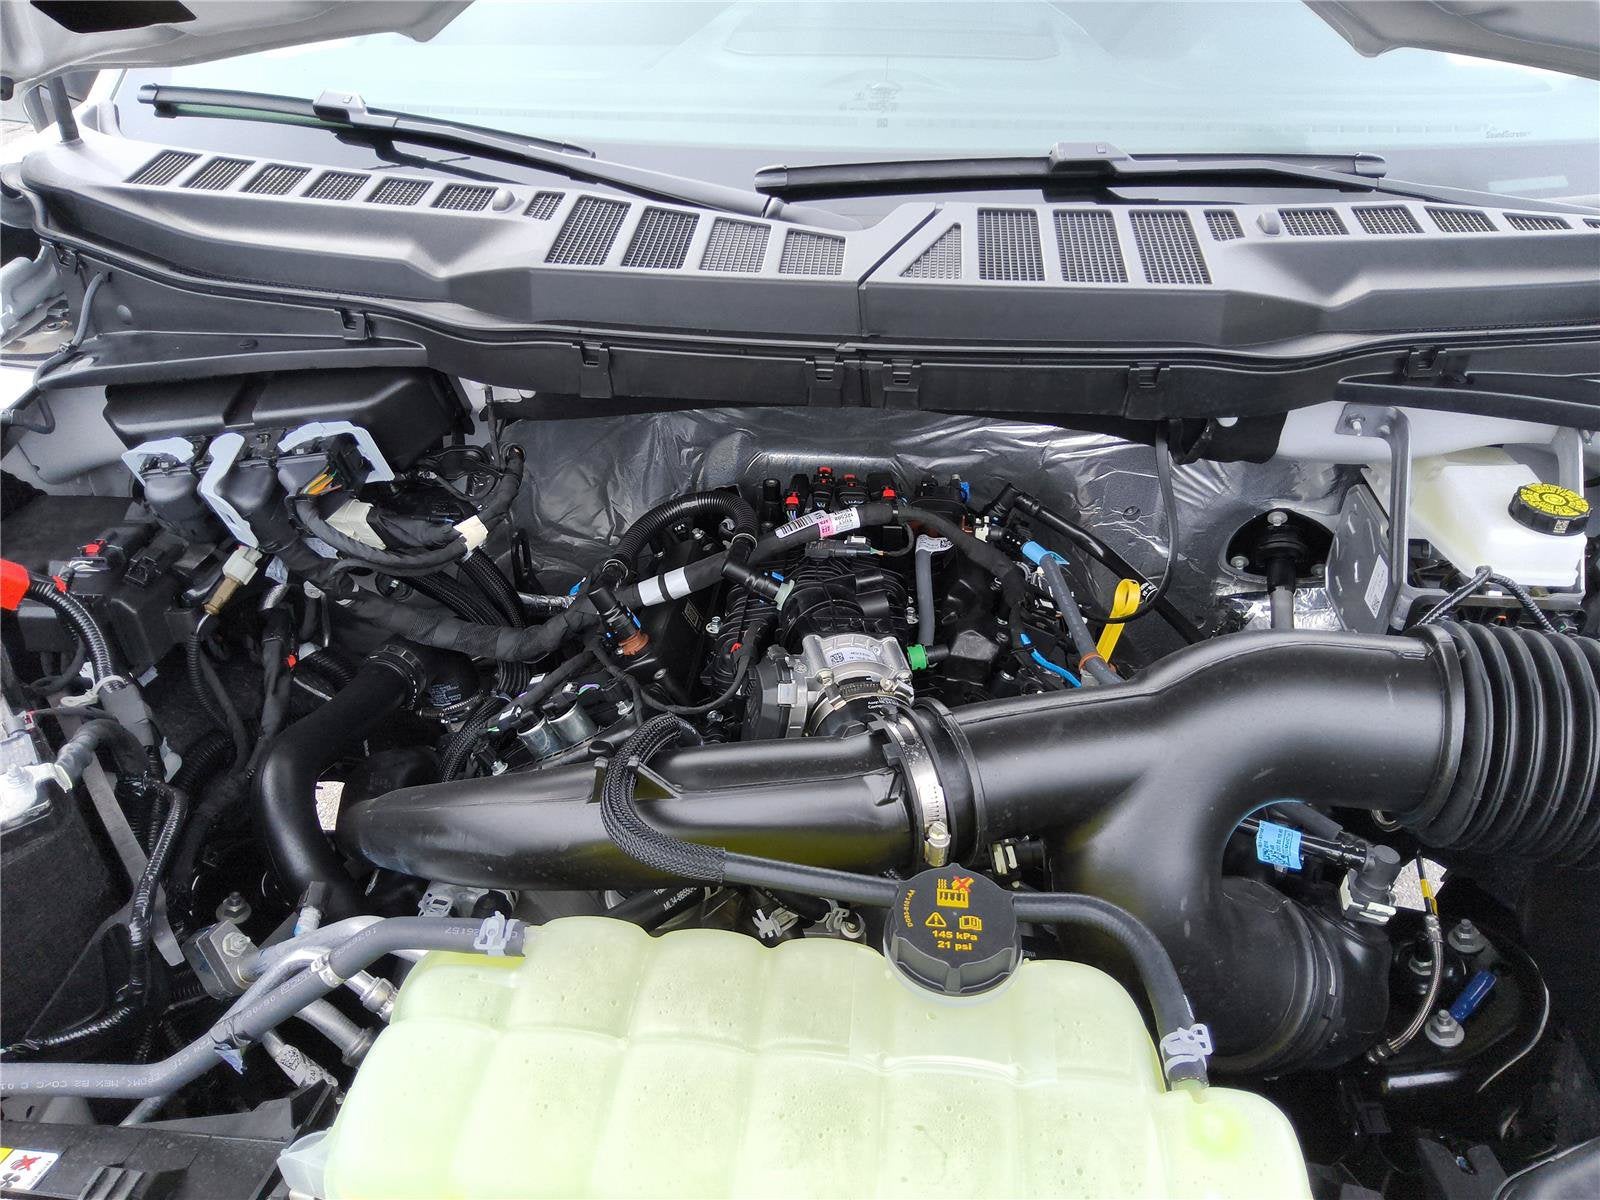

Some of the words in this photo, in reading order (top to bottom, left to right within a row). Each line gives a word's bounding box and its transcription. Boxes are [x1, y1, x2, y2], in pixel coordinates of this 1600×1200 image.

[932, 929, 953, 939] 145
[955, 931, 978, 941] kPa
[936, 940, 951, 949] 21
[954, 942, 972, 952] psi
